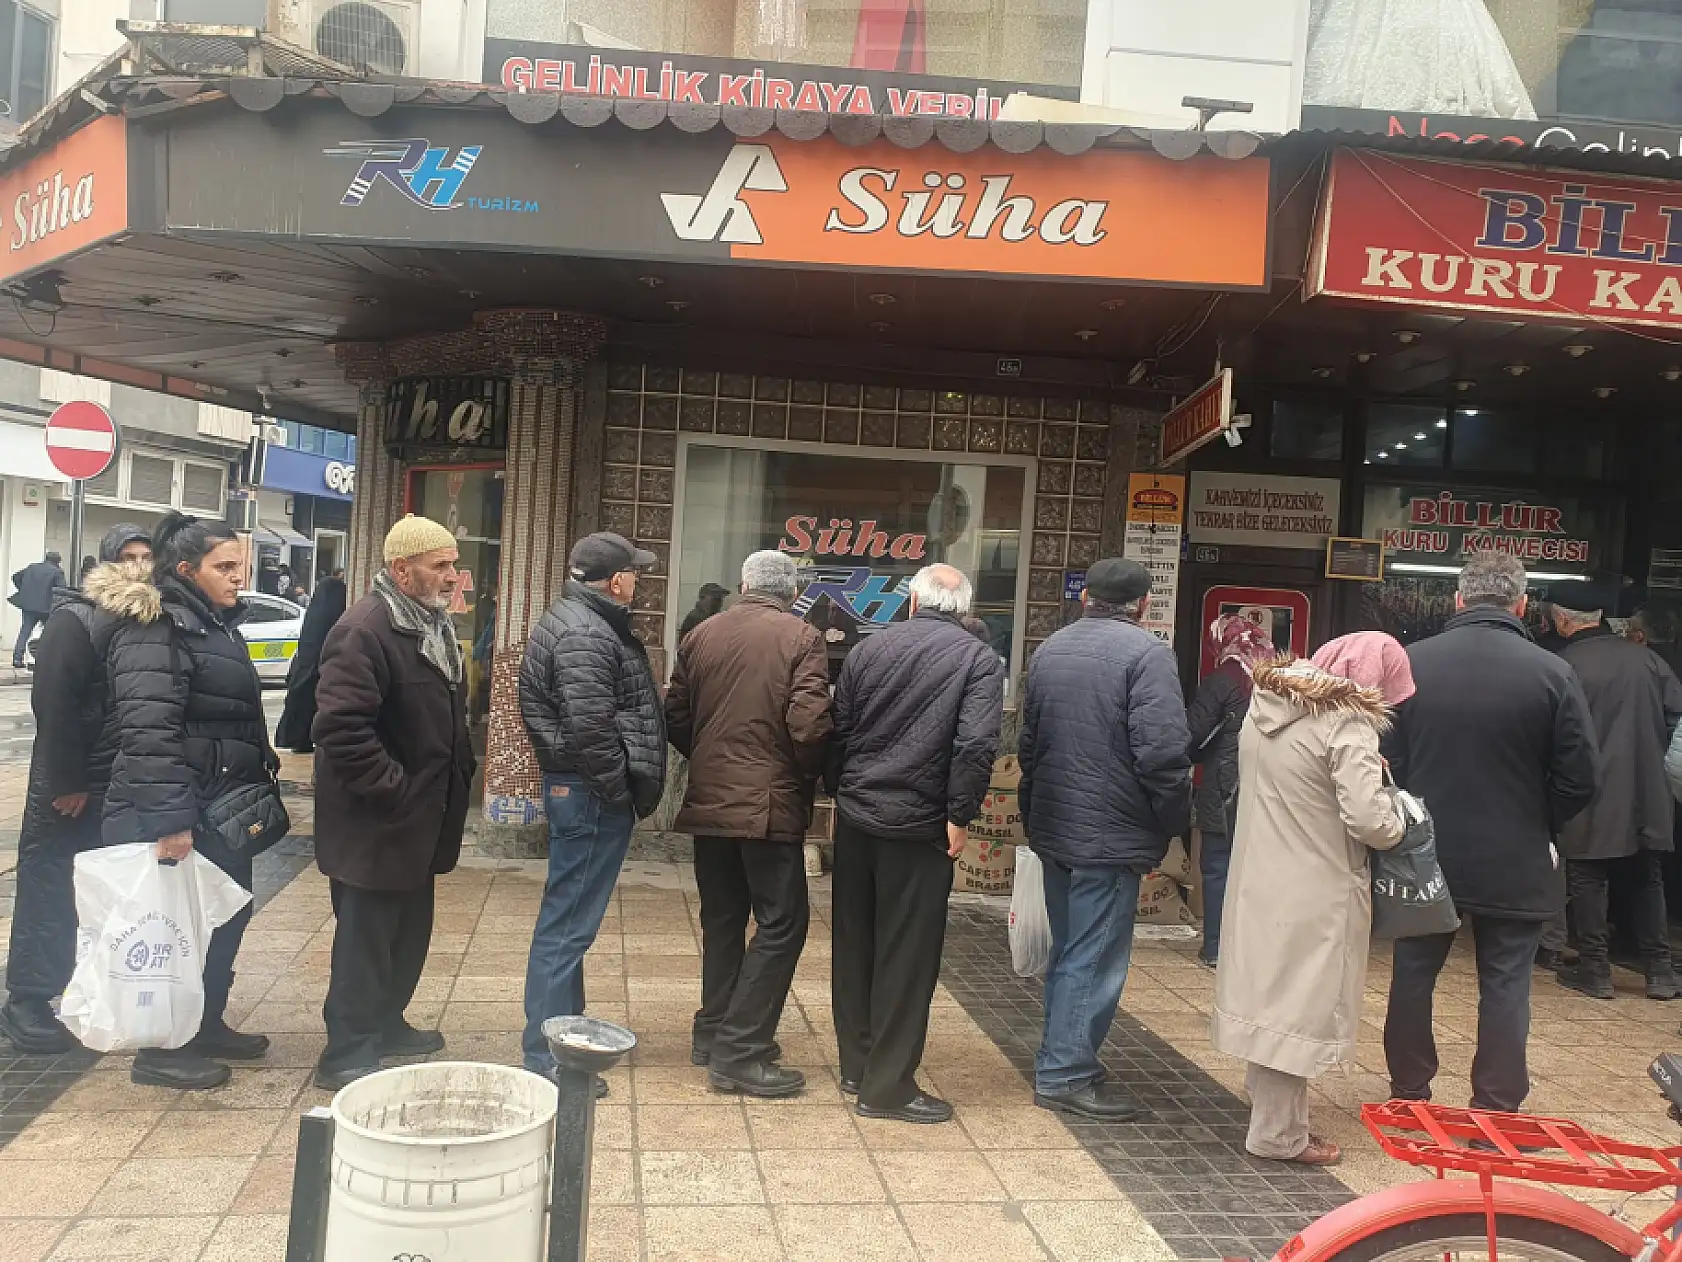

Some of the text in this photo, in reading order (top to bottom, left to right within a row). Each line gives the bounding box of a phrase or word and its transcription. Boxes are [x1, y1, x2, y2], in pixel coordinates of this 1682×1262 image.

[502, 55, 708, 103] GELİNLİK
[718, 68, 874, 114] KİRAYA
[9, 169, 95, 254] Süha
[467, 196, 540, 213] TURİZM
[824, 167, 1108, 246] Süha
[1361, 247, 1563, 301] KURU
[778, 514, 927, 560] Süha
[1384, 528, 1449, 553] KURU
[967, 823, 1015, 838] BRASIL
[965, 877, 1012, 890] BRASIL
[111, 926, 137, 951] DAHA
